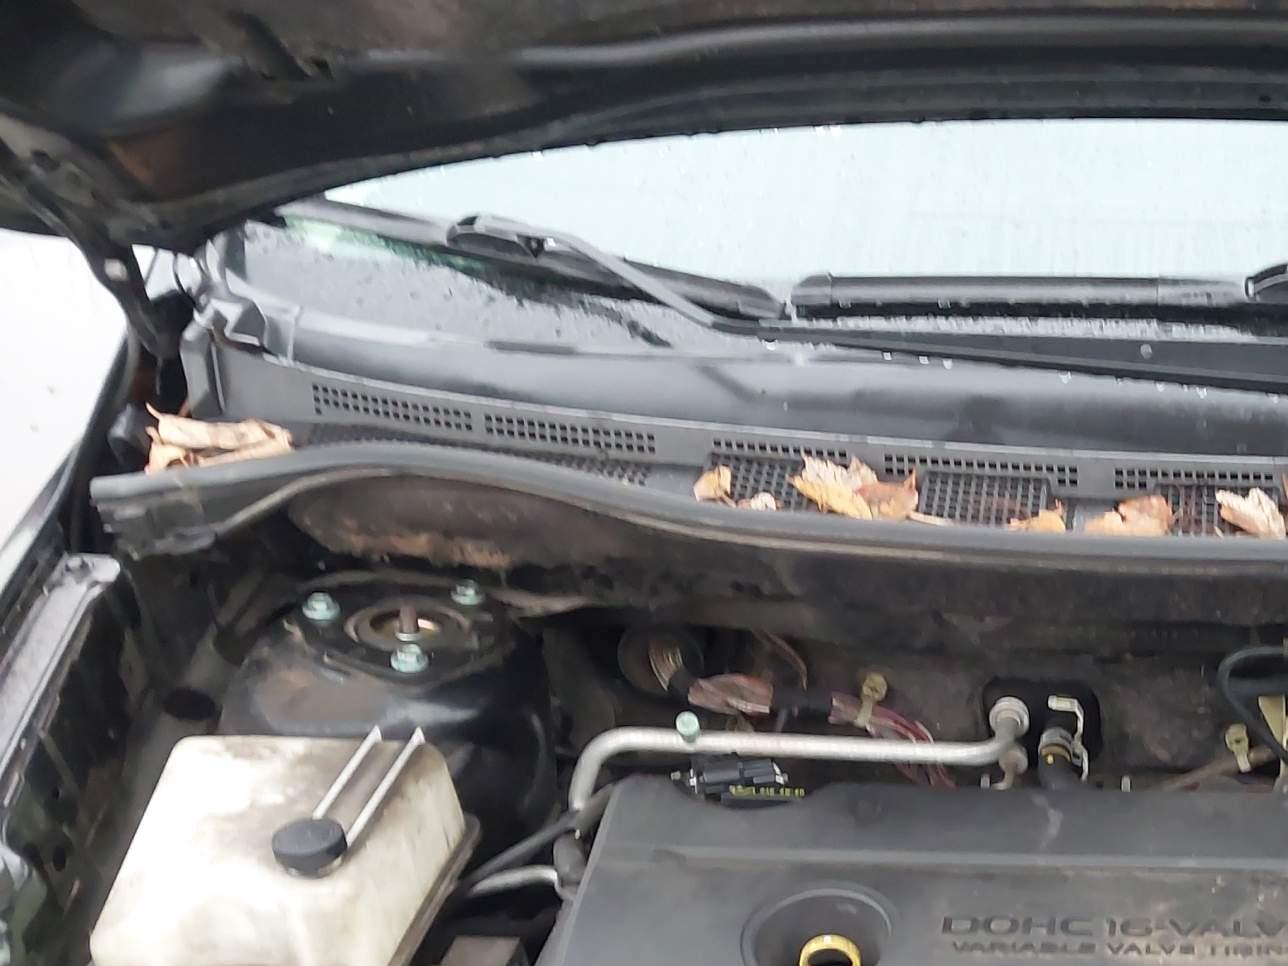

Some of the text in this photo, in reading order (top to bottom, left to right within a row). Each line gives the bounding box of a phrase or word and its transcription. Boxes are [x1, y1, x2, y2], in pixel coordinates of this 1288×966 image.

[941, 915, 1093, 937] DOHC
[952, 940, 1096, 955] VARIABLE
[1106, 942, 1196, 956] VALVE
